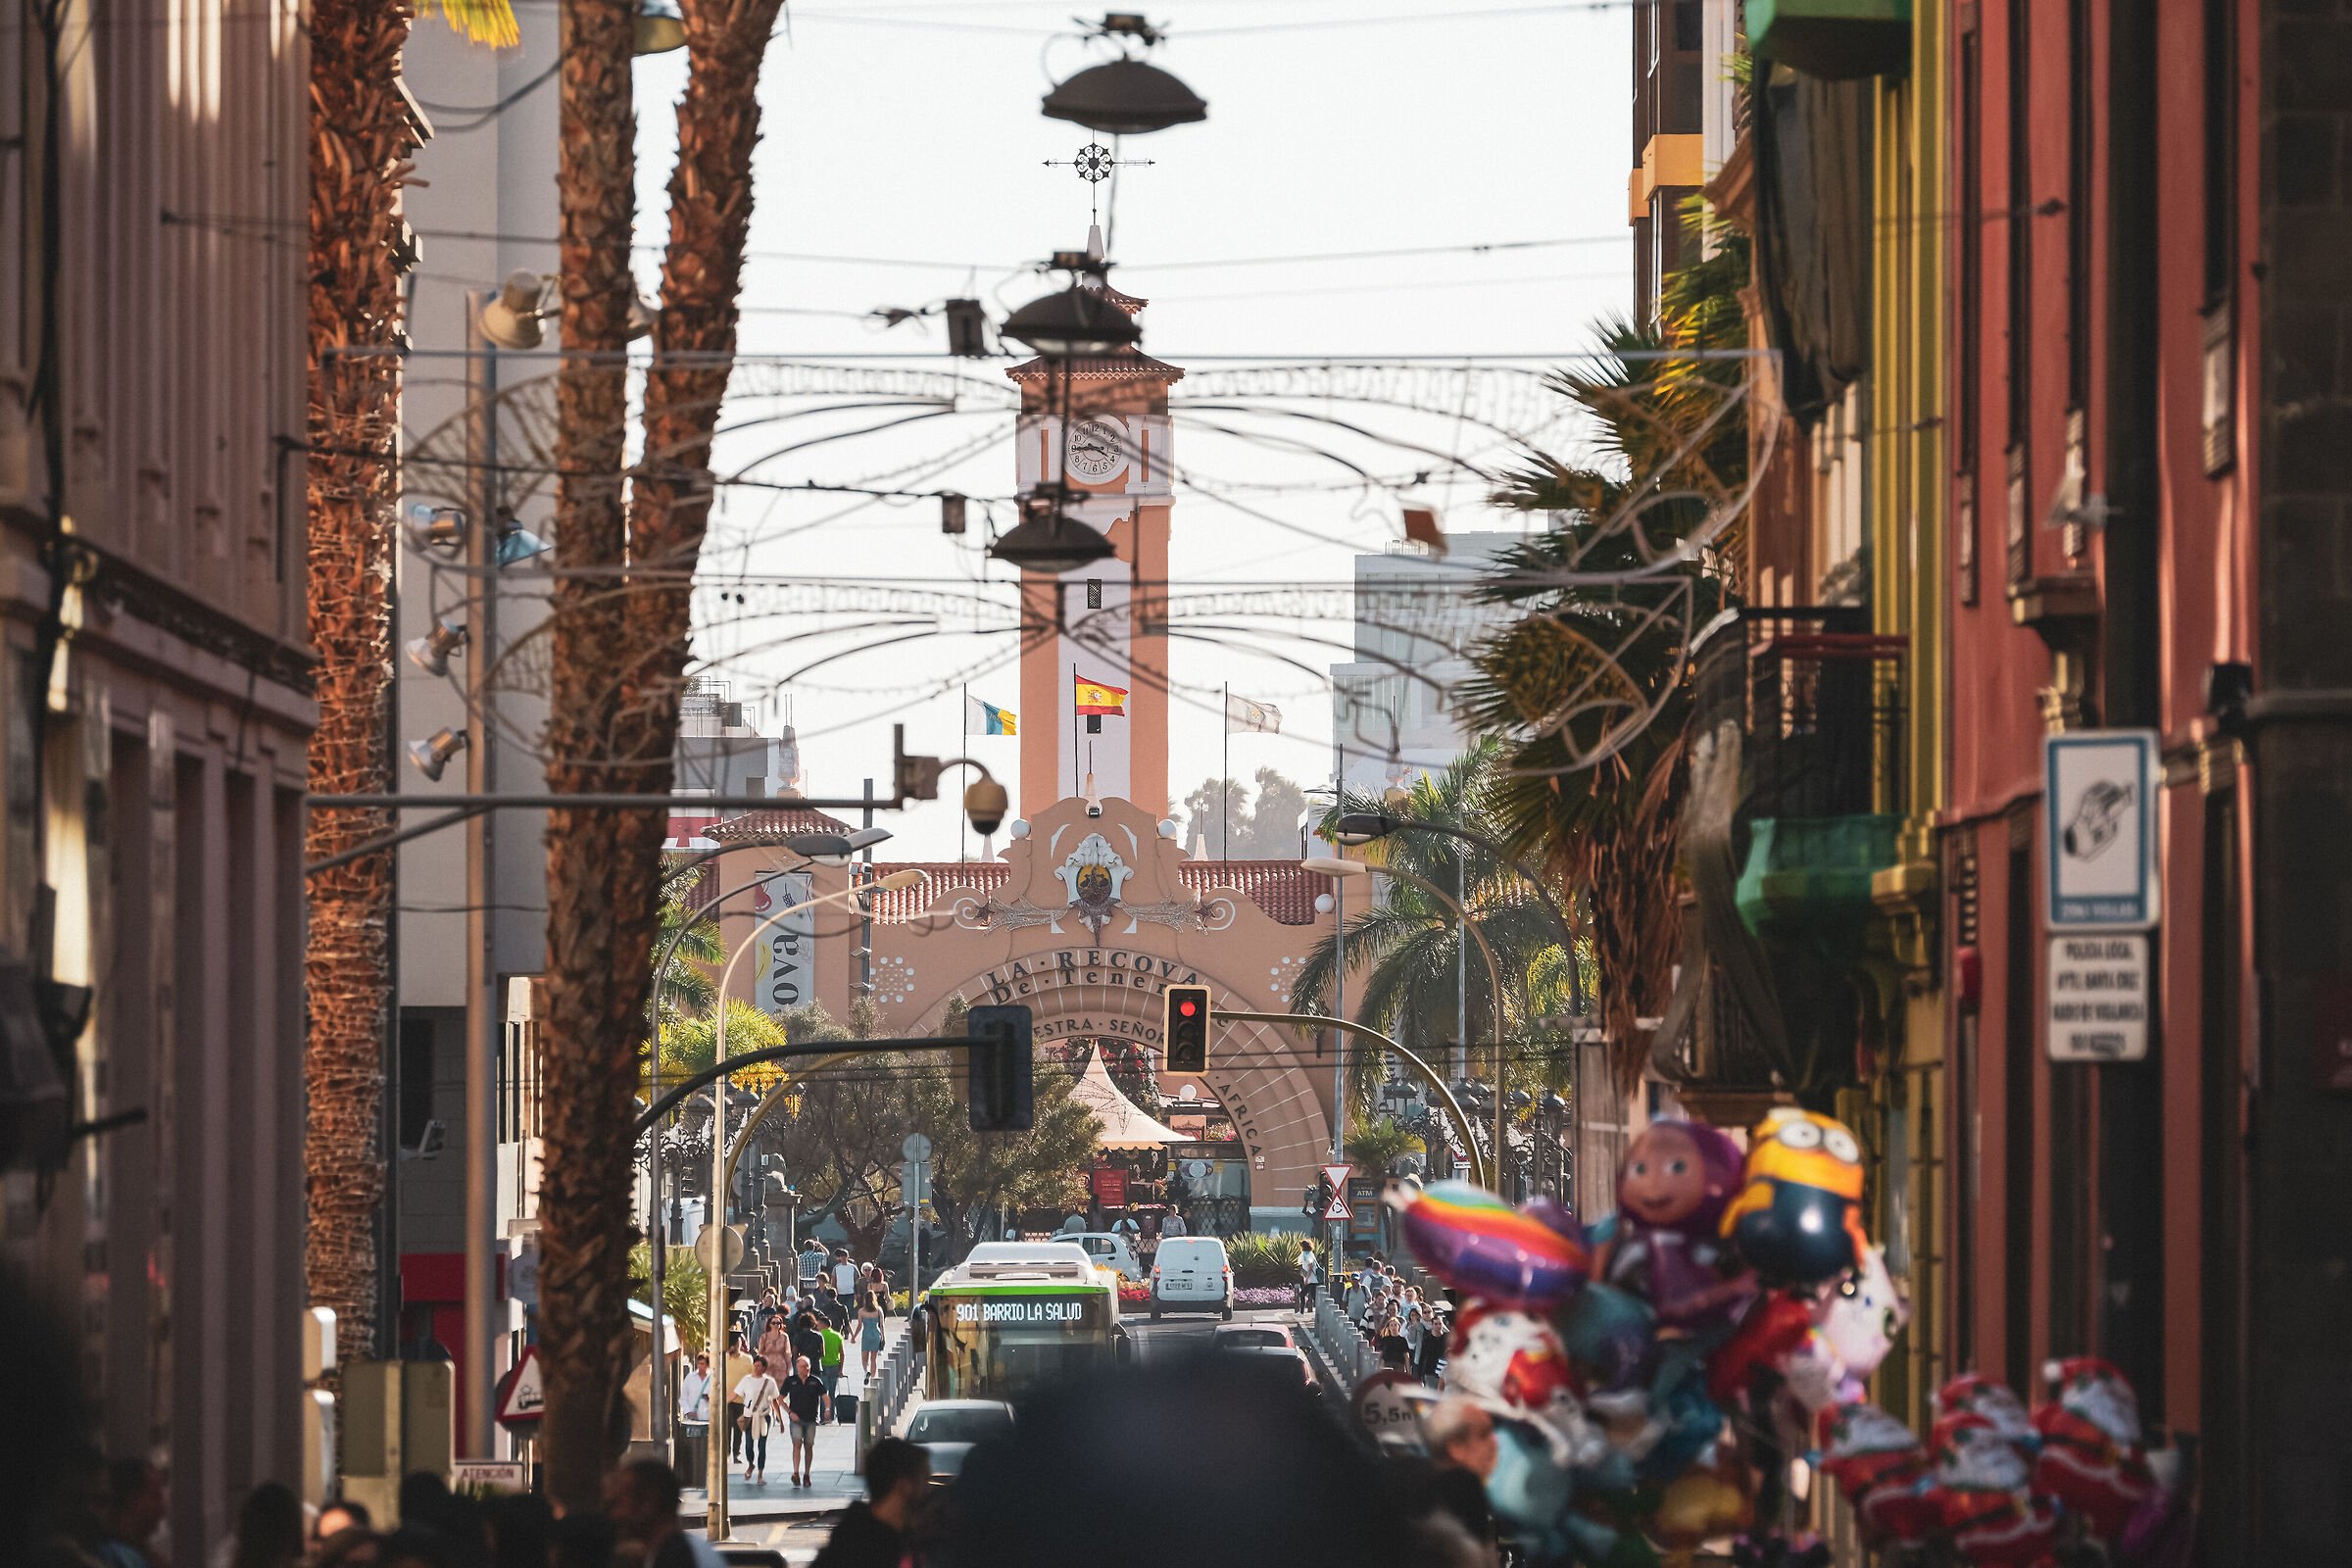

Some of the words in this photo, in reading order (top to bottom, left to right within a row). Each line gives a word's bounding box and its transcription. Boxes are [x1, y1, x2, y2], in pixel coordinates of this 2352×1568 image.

[987, 961, 1029, 987] LA
[1057, 950, 1197, 986] RECOVA
[990, 982, 1031, 1004] De
[1033, 1018, 1093, 1039] ESTRA
[1109, 1018, 1164, 1044] SEÑOR
[1216, 1083, 1263, 1156] AFRICA
[956, 1302, 979, 1322] 901
[983, 1302, 1024, 1321] BARRIO
[1027, 1302, 1043, 1321] LA
[1046, 1302, 1082, 1320] SALUD
